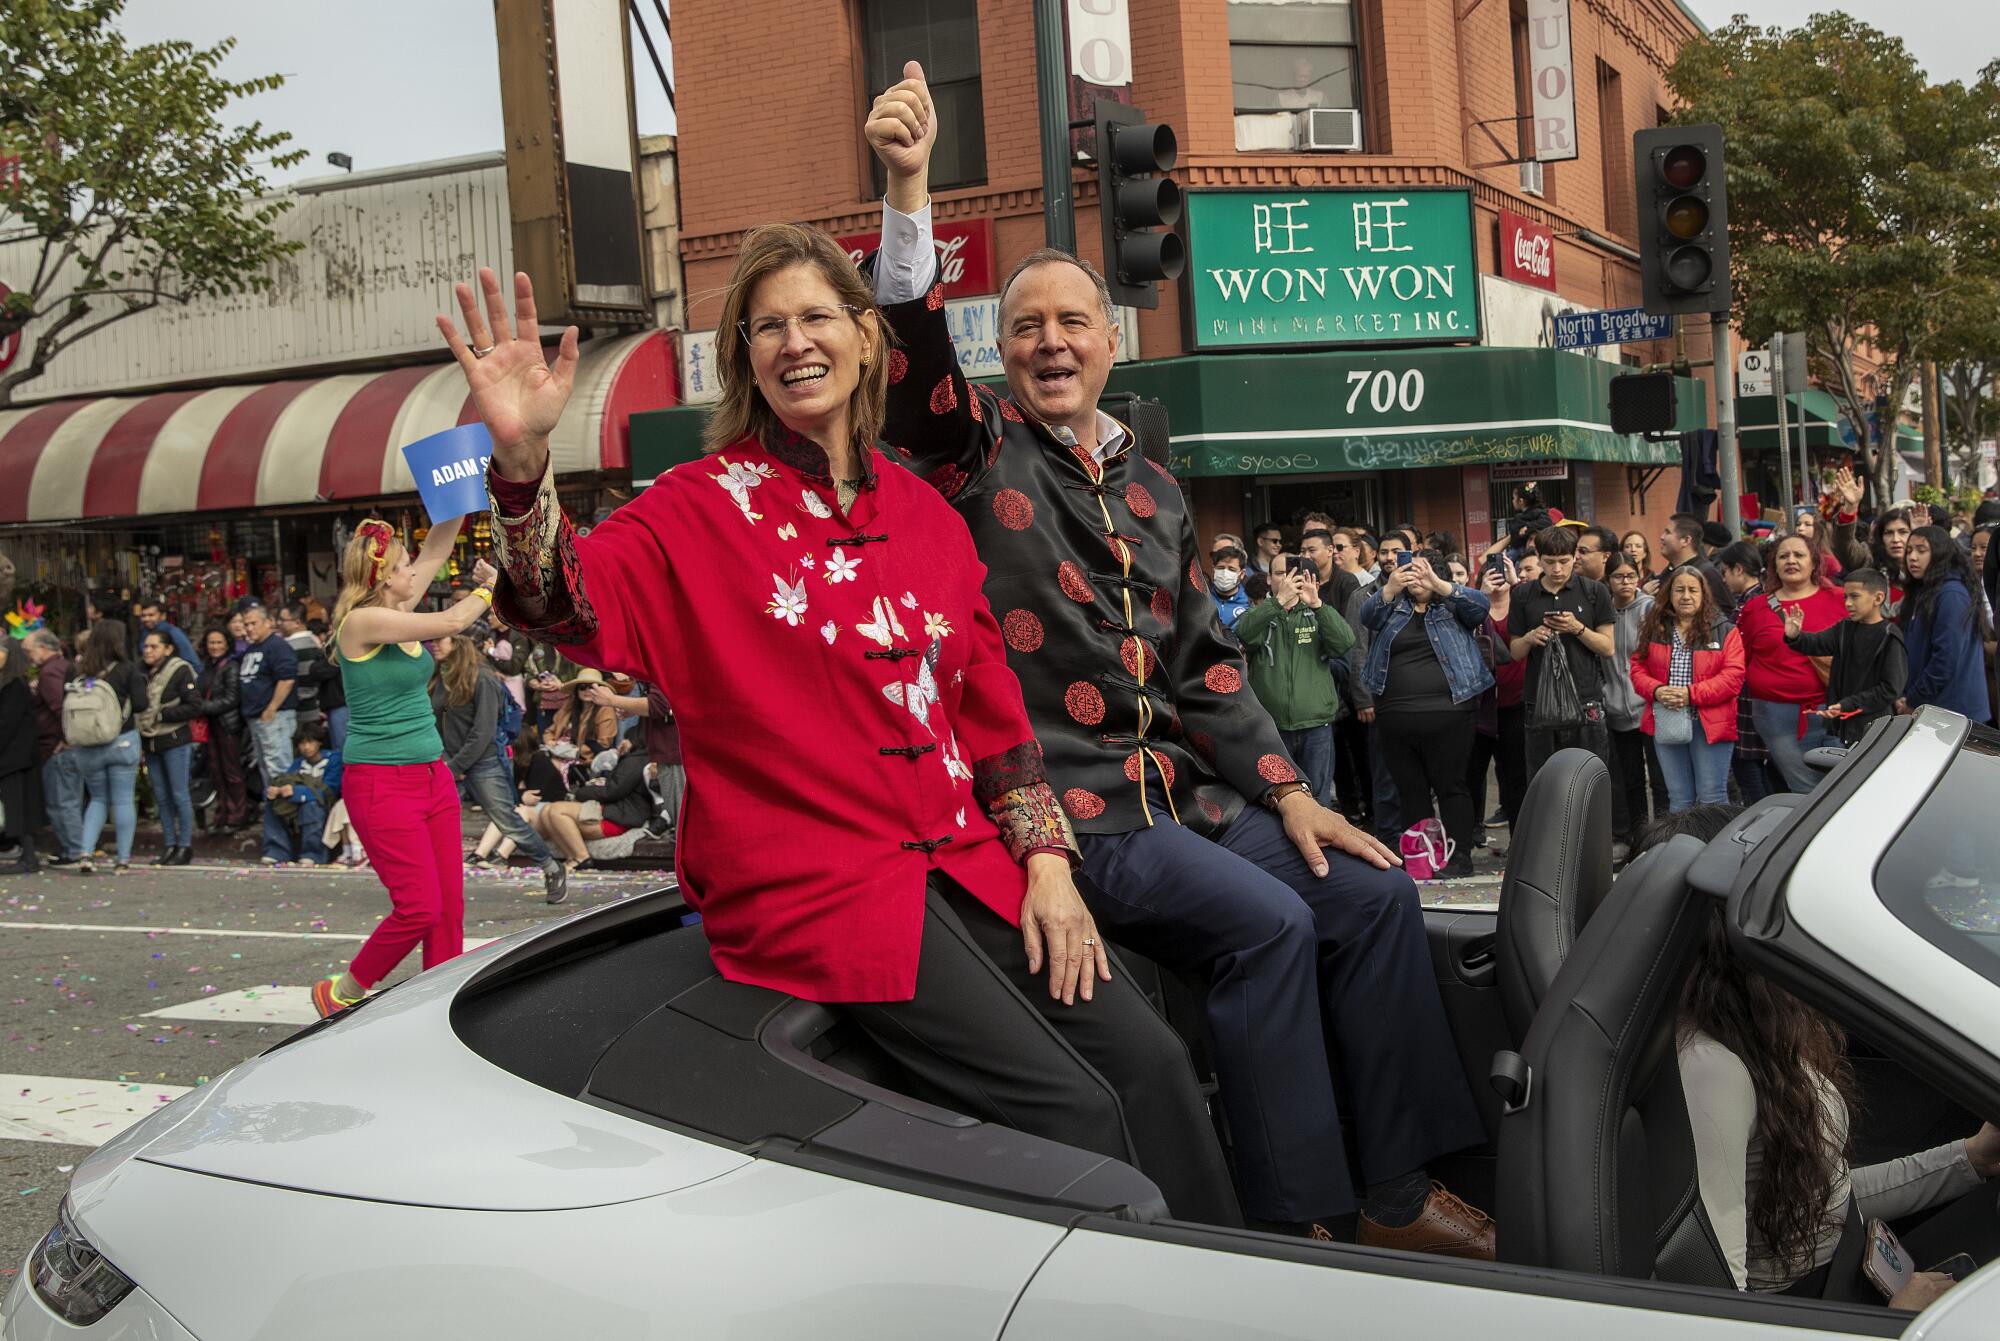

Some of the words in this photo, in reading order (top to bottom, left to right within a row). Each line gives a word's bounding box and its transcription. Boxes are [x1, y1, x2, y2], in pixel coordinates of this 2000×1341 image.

[1206, 267, 1328, 303] WON
[1338, 264, 1455, 301] WON
[1213, 316, 1278, 336] MINI
[1291, 312, 1402, 333] MARKET
[1414, 311, 1470, 331] INC.
[1558, 315, 1595, 335] North
[1600, 310, 1666, 331] Broadway
[1557, 334, 1577, 347] 700
[1584, 332, 1591, 344] N
[1346, 368, 1425, 414] 700
[1742, 383, 1756, 393] 96
[432, 458, 480, 486] ADAM
[480, 456, 491, 473] S
